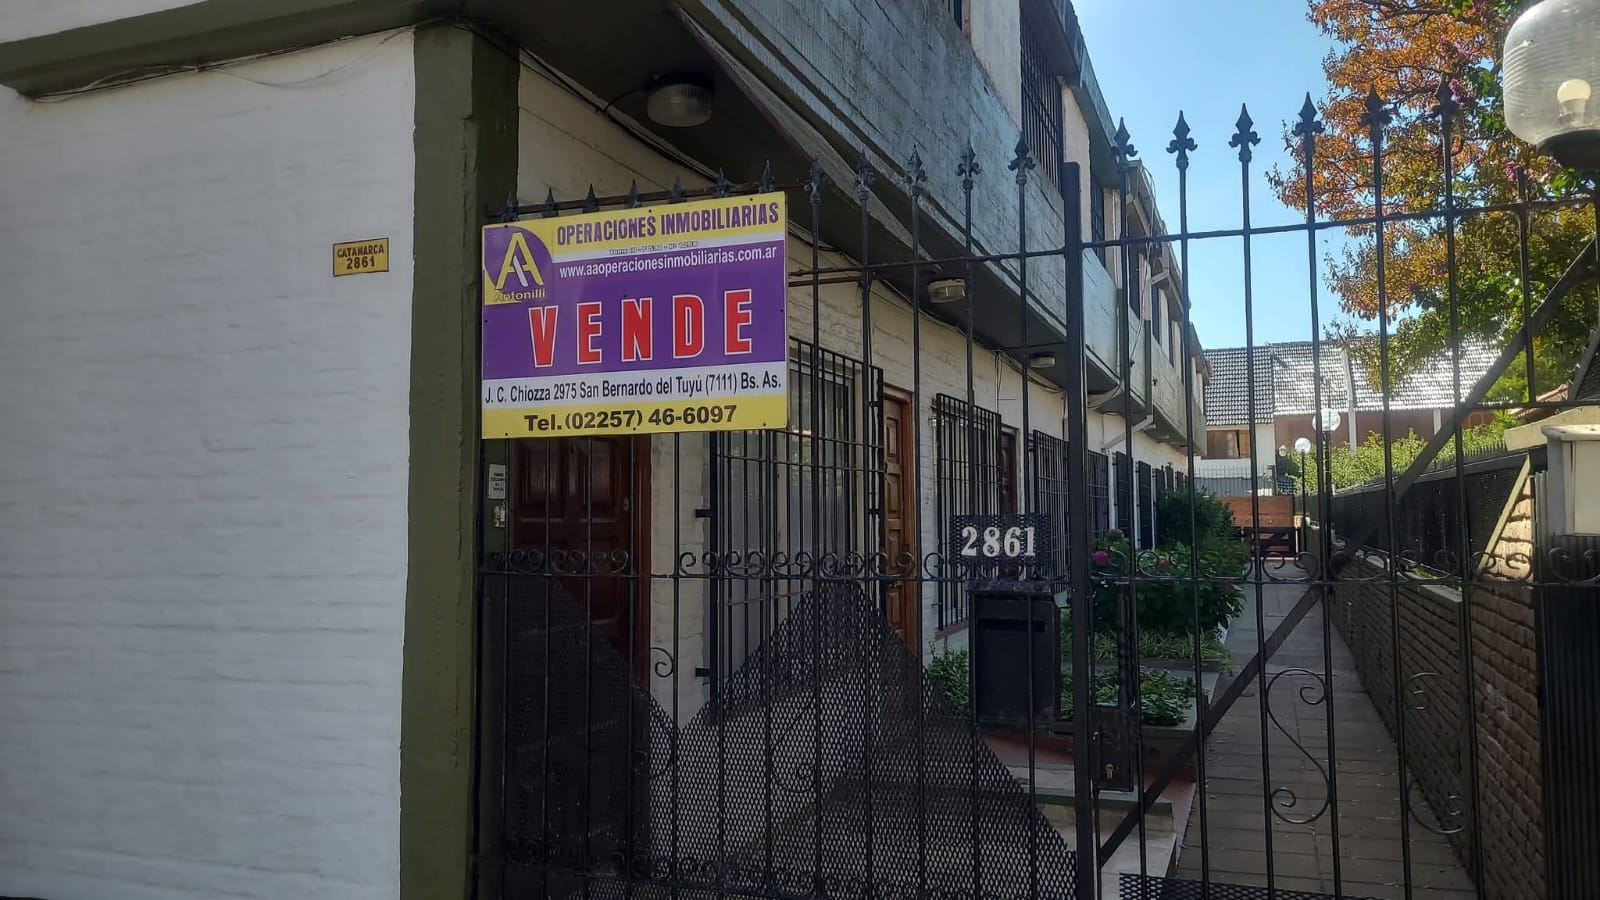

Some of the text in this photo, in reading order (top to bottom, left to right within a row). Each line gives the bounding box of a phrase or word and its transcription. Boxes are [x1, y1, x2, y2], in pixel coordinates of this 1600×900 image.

[557, 202, 779, 246] OPERACIONES INMOBILIARIAS
[337, 244, 385, 258] CATAMARCA
[346, 255, 376, 270] 2861
[560, 245, 777, 279] www.aaoperacionesinmobiliarias.com.ar
[528, 288, 752, 368] VENDE
[485, 370, 782, 404] J. C. Chiozza 2975 San Bernardo del Tuyú (7111) Bs. As.
[648, 404, 737, 426] 46-6097
[960, 526, 1036, 557] 2861
